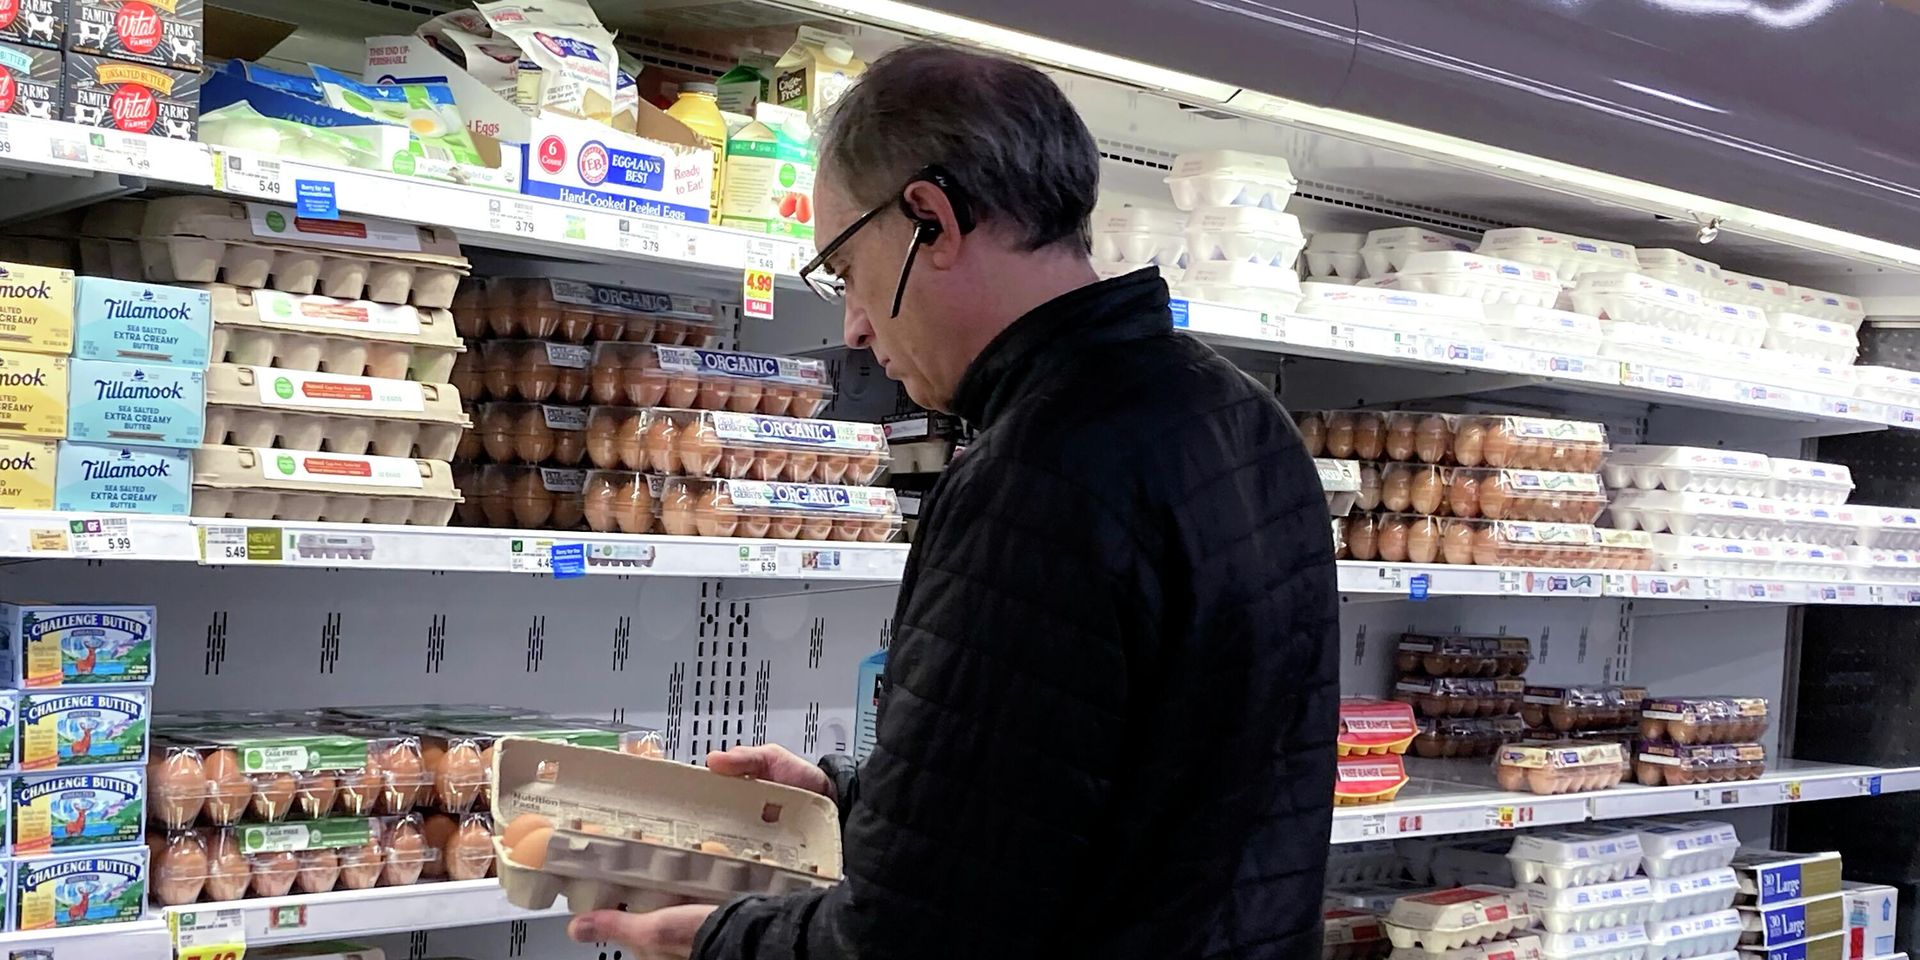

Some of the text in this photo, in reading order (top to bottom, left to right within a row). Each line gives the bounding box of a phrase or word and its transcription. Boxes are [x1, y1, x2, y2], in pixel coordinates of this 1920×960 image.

[20, 0, 53, 14] FARMS
[82, 6, 117, 25] FAMILY
[118, 10, 157, 37] Vital
[163, 22, 195, 39] FARMS
[17, 83, 50, 100] FARMS
[78, 91, 113, 108] FAMILY
[113, 94, 150, 119] Vital
[158, 104, 190, 120] FARMS
[475, 120, 499, 136] Eggs
[549, 142, 557, 153] 6
[542, 156, 562, 167] Count
[587, 158, 602, 171] EB
[625, 170, 648, 184] BEST
[674, 162, 701, 181] Ready
[259, 180, 281, 194] 5.49
[676, 185, 685, 194] to
[559, 187, 686, 221] Hard-Cooked Peeled Eggs
[515, 220, 534, 233] 3.79
[746, 273, 772, 292] 4.99
[597, 288, 669, 312] ORGANIC
[104, 299, 191, 320] Tillamook
[127, 324, 167, 334] SEA SALTED
[114, 331, 179, 345] EXTRA CREAMY
[133, 342, 159, 351] BUTTER
[705, 353, 775, 375] ORGANIC
[94, 379, 184, 400] Tillamook
[118, 405, 159, 415] SEA SALTED
[105, 412, 172, 425] EXTRA CREAMY
[124, 422, 151, 431] BUTTER
[761, 420, 832, 440] ORGANIC
[81, 459, 170, 481] Tillamook
[91, 492, 157, 502] EXTRA CREAMY
[120, 485, 145, 493] SALTED
[776, 486, 845, 504] ORGANIC
[110, 501, 137, 509] BUTTER
[108, 537, 131, 550] 5.99
[226, 546, 246, 558] 5.49
[761, 561, 777, 572] 6.59
[32, 615, 143, 636] CHALLENGE BUTTER
[28, 695, 138, 717] CHALLENGE BUTTER
[1347, 720, 1390, 729] FREE RANGE
[1341, 768, 1380, 777] FREE RANGE
[21, 776, 134, 800] CHALLENGE BUTTER
[513, 793, 559, 807] Nutrition
[27, 860, 138, 886] CHALLENGE BUTTER
[1763, 873, 1775, 886] 30
[1776, 872, 1800, 897] Large
[1769, 914, 1780, 928] 30
[1781, 913, 1805, 938] Large
